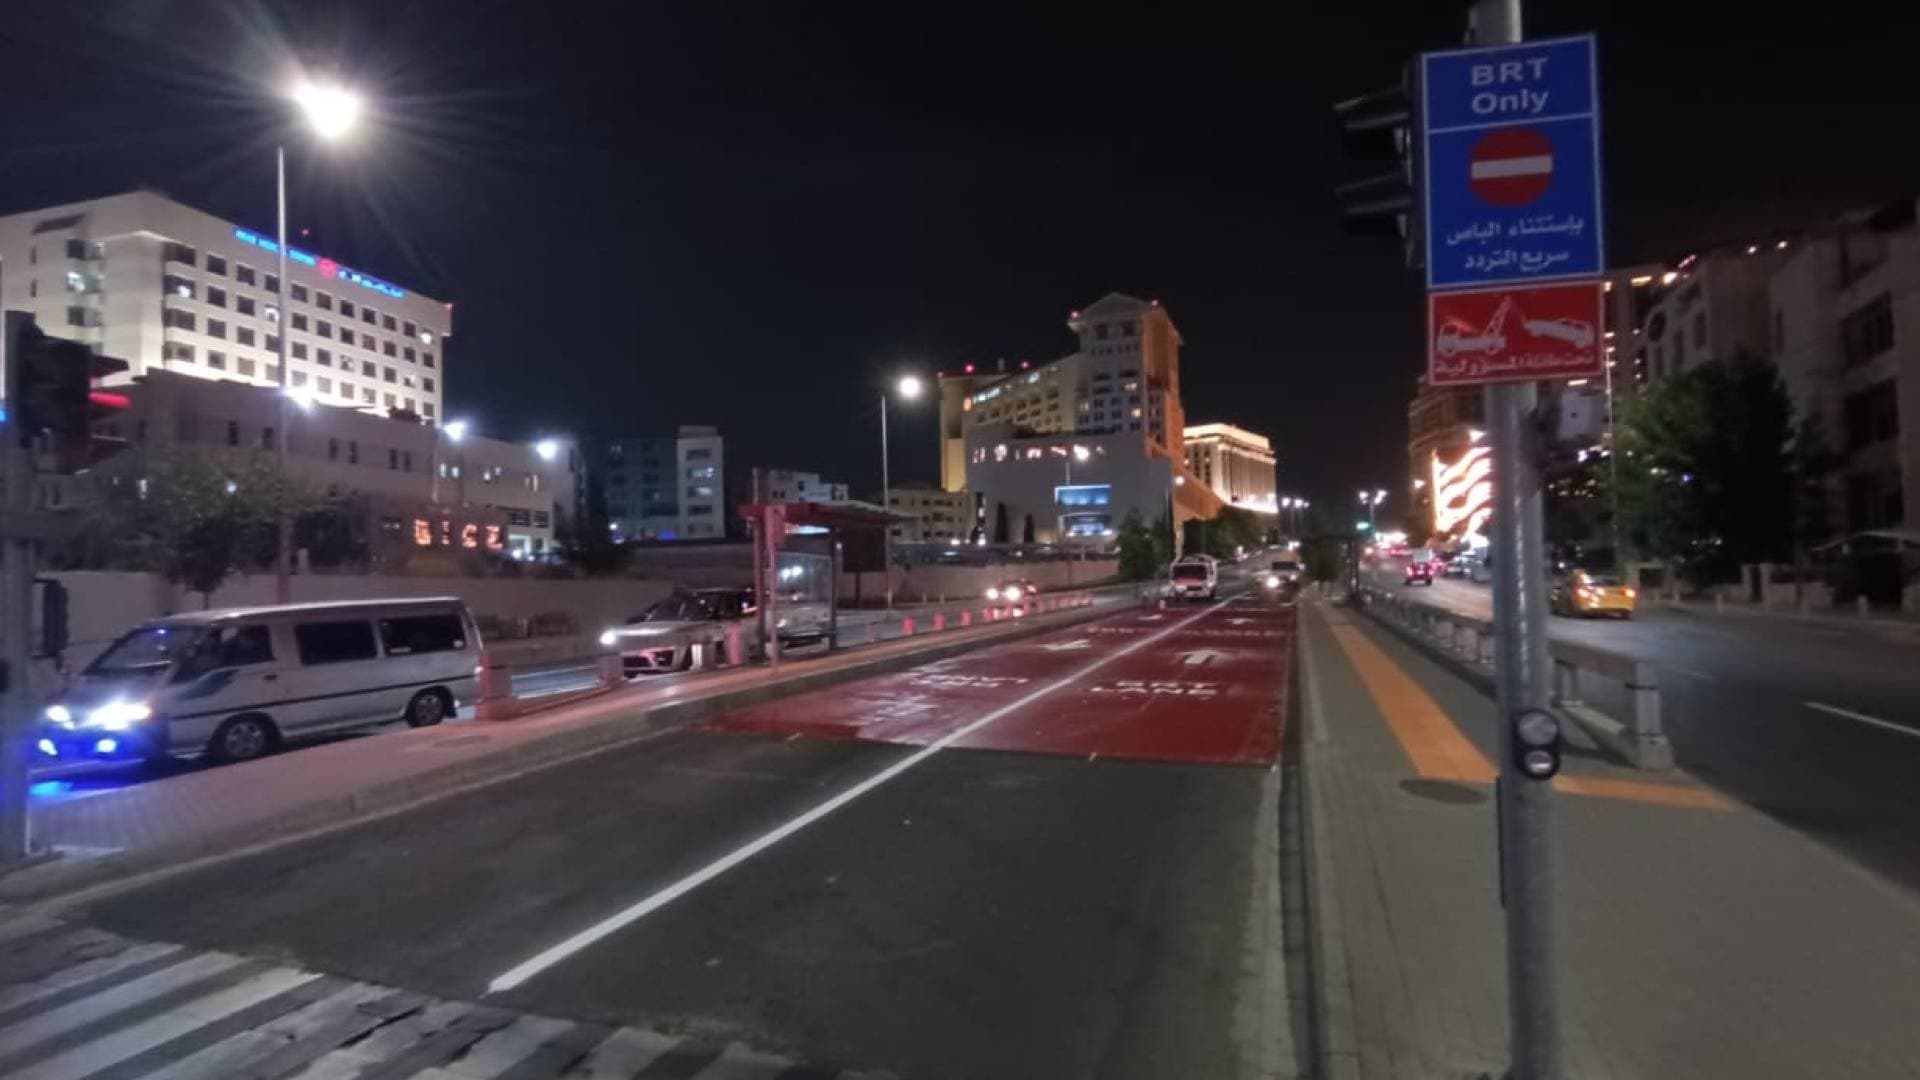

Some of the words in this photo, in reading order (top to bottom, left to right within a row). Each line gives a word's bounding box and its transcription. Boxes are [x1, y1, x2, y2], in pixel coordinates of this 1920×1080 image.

[1472, 57, 1548, 86] BRT
[1472, 89, 1549, 114] Only
[1446, 222, 1500, 245] الباص
[1465, 250, 1517, 271] التردد
[1519, 252, 1568, 272] سريع
[1564, 350, 1594, 365] تحت
[1090, 687, 1218, 696] LANE
